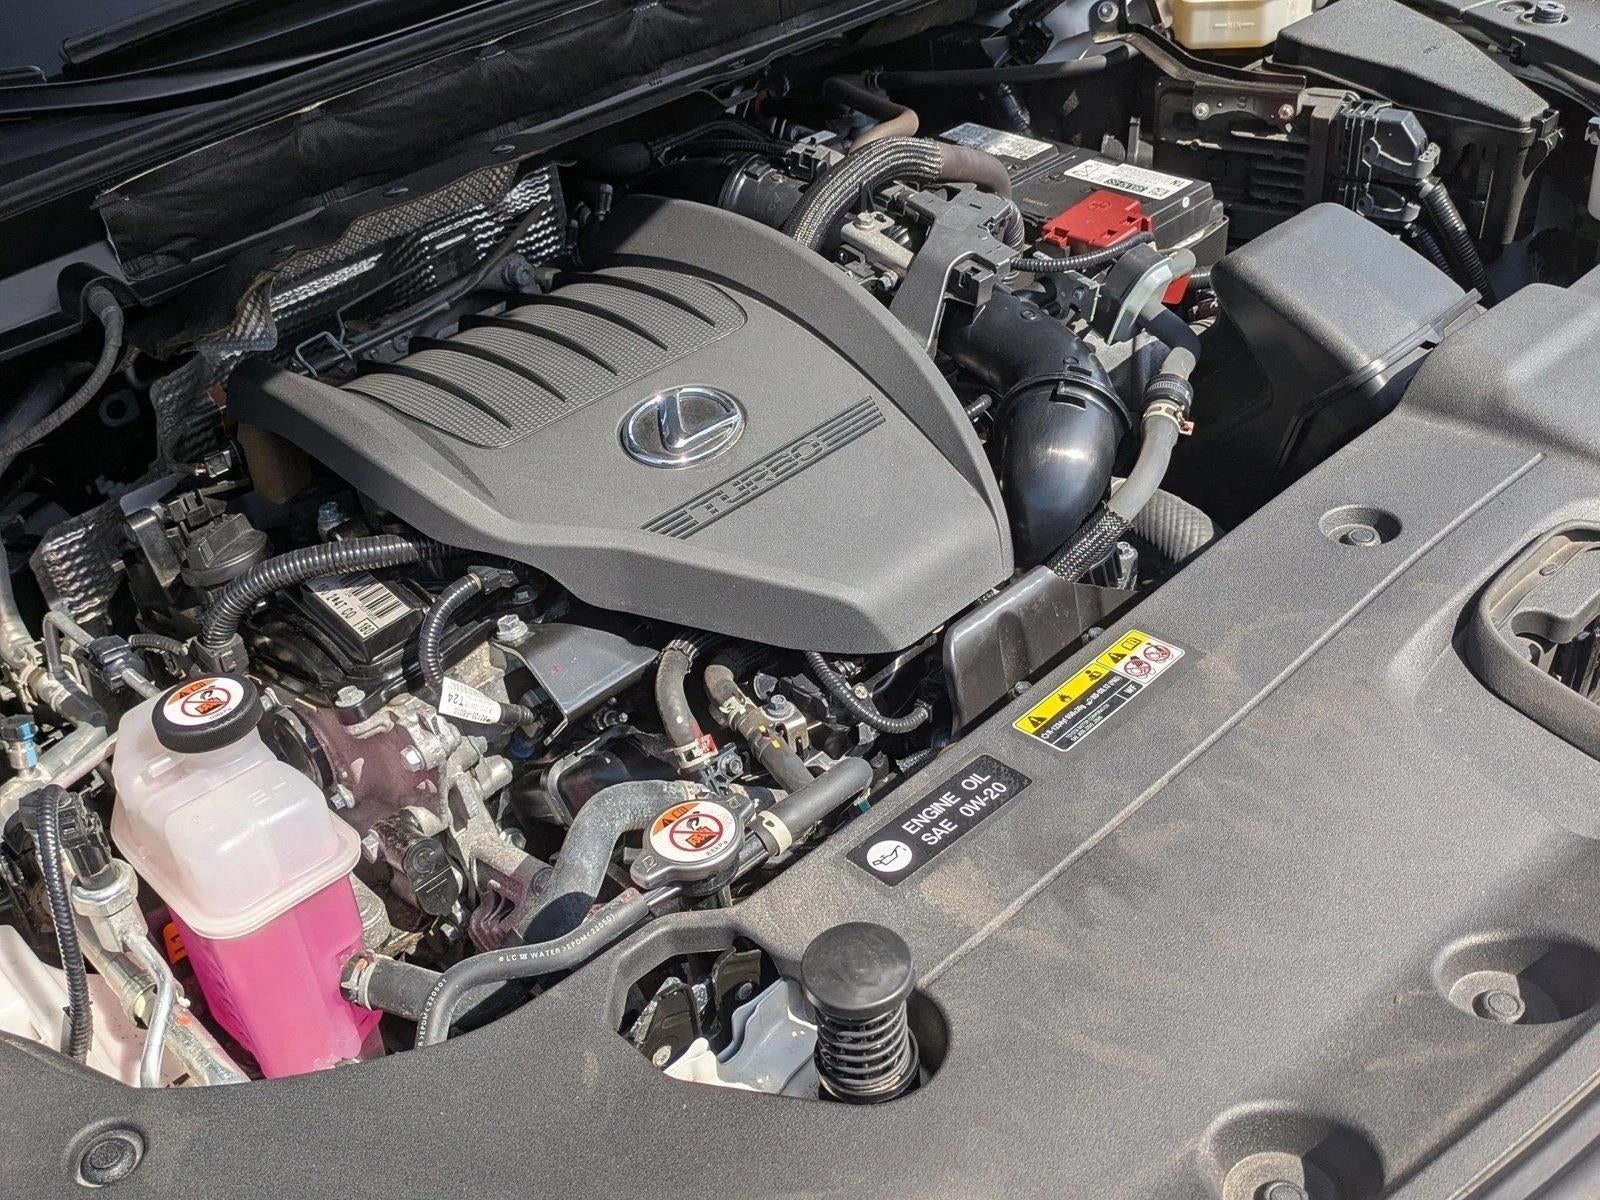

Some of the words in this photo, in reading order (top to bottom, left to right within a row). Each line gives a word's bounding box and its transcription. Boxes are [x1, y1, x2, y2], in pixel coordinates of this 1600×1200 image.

[688, 439, 823, 515] TURBO
[447, 692, 464, 707] T24
[901, 791, 961, 835] ENGINE
[961, 772, 991, 791] OIL
[921, 818, 959, 846] SAE
[959, 782, 1007, 818] 0W-20
[530, 946, 562, 960] WATER
